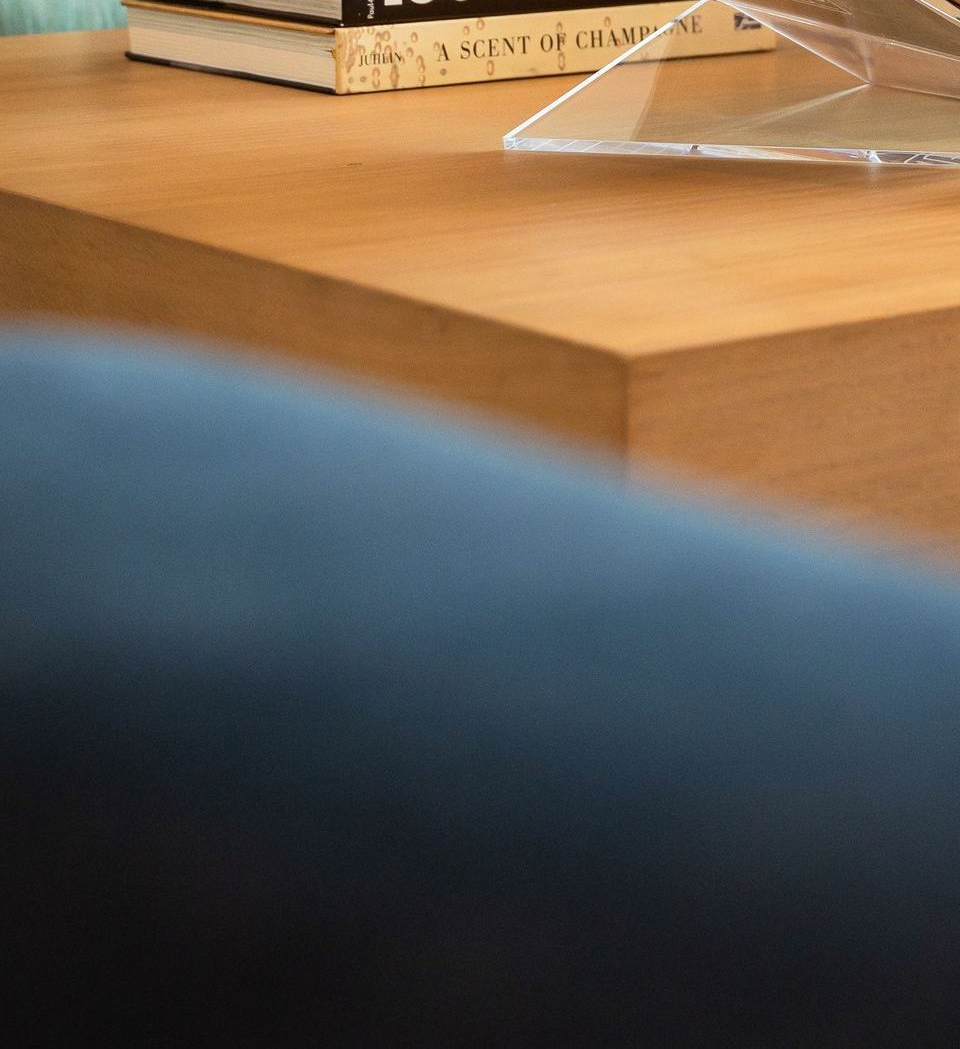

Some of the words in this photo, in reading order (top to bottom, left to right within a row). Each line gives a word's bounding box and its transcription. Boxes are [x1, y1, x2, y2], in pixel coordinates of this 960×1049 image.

[437, 43, 450, 62] A
[460, 36, 531, 60] SCENT
[540, 32, 567, 53] OF
[576, 15, 703, 49] CHAMPNE
[359, 52, 402, 67] JUHLIN
